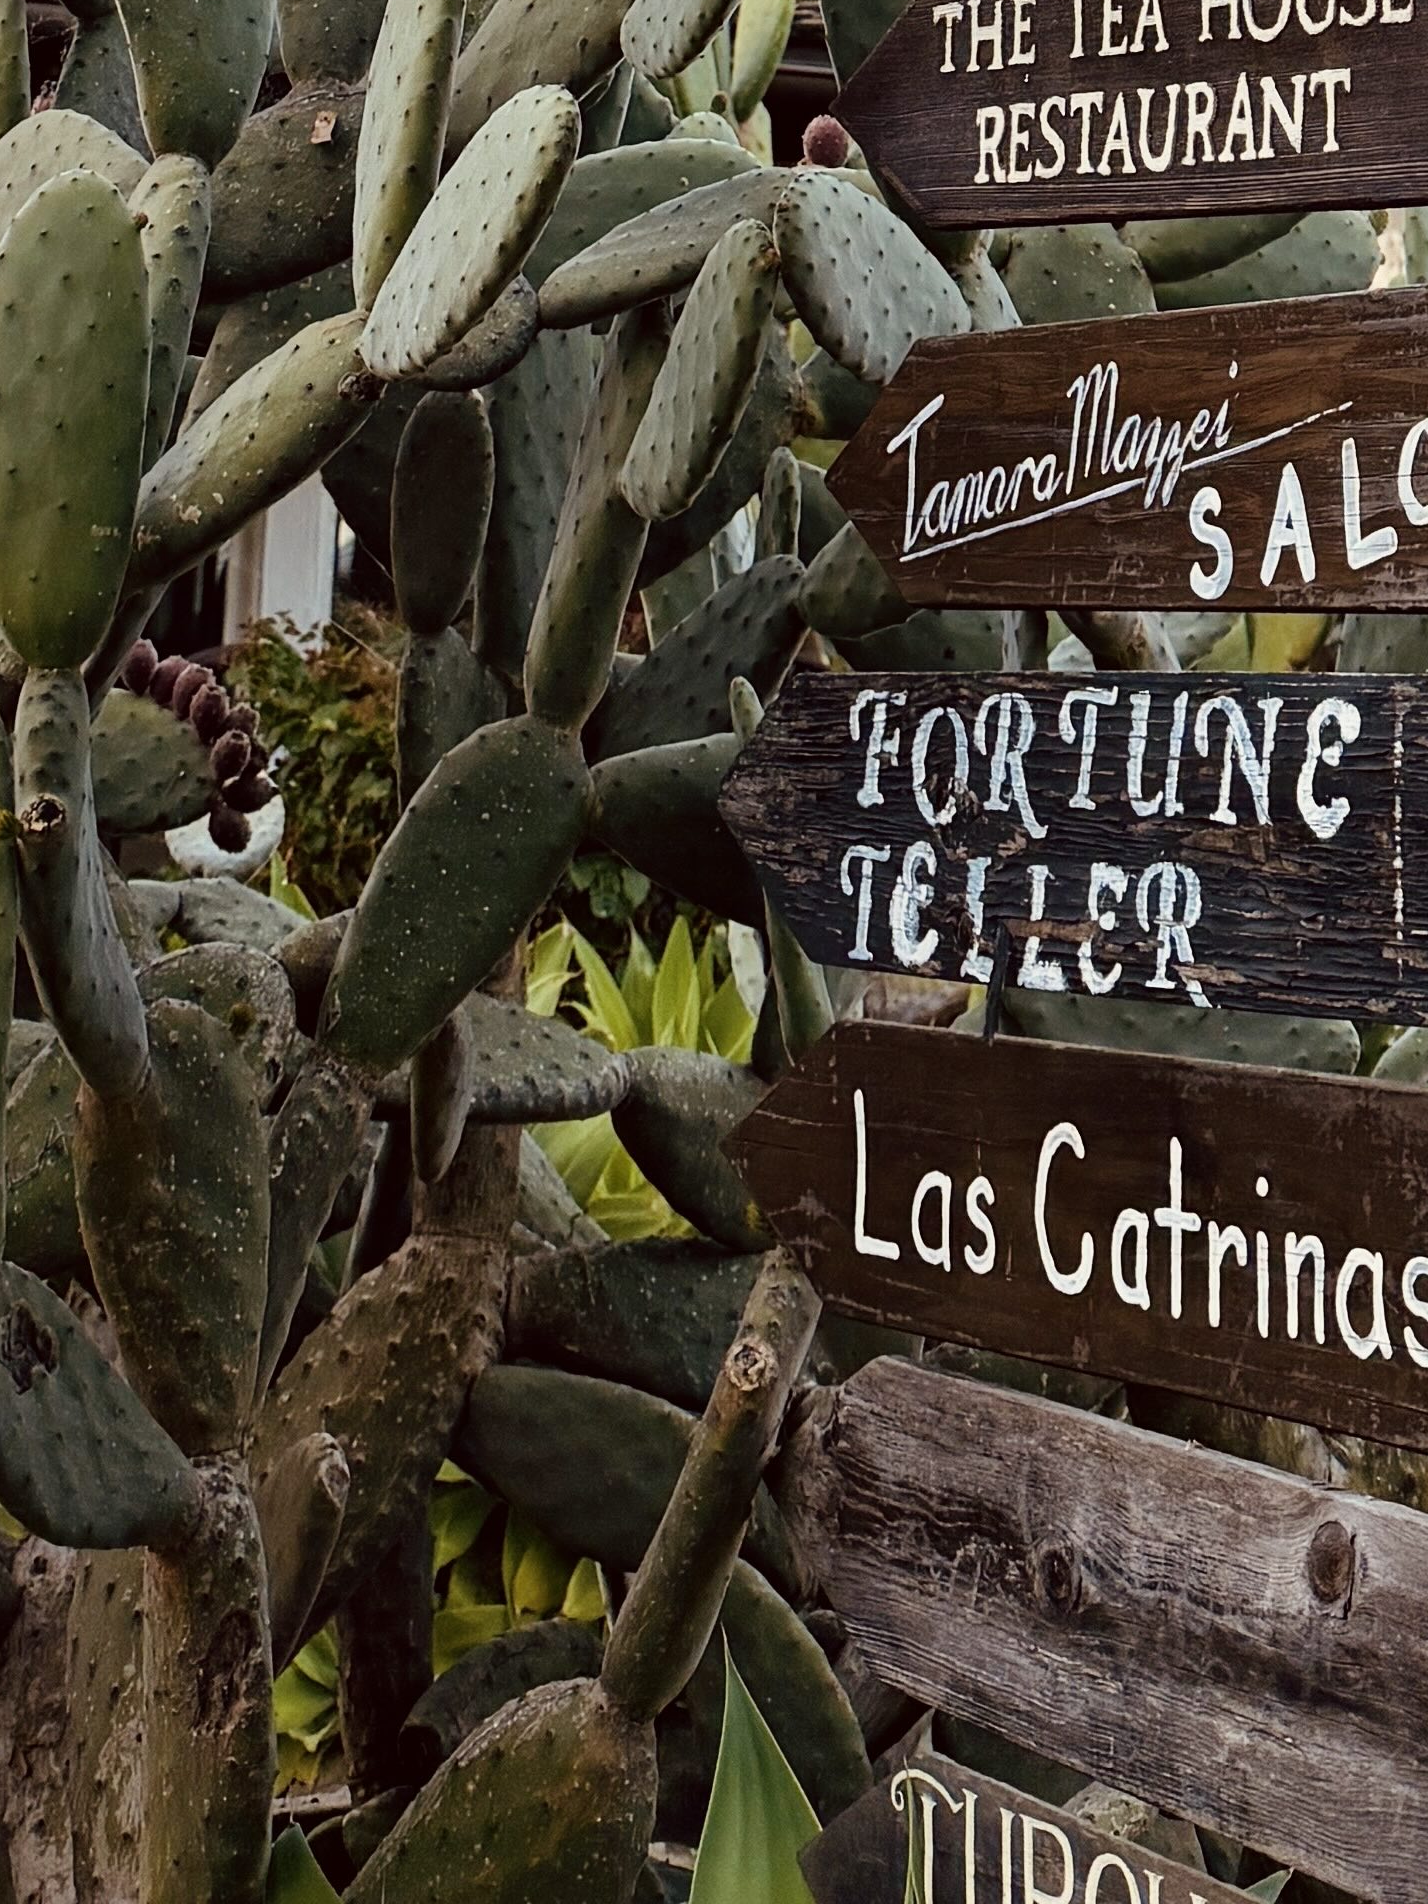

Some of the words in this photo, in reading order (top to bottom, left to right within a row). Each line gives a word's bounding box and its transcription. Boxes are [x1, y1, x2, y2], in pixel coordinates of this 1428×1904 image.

[974, 68, 1352, 185] RESTAURANT
[887, 393, 1064, 554] Tamara
[848, 687, 1363, 840] FORTUNE
[840, 839, 1222, 1009] TELLER
[852, 1088, 997, 1276] Las
